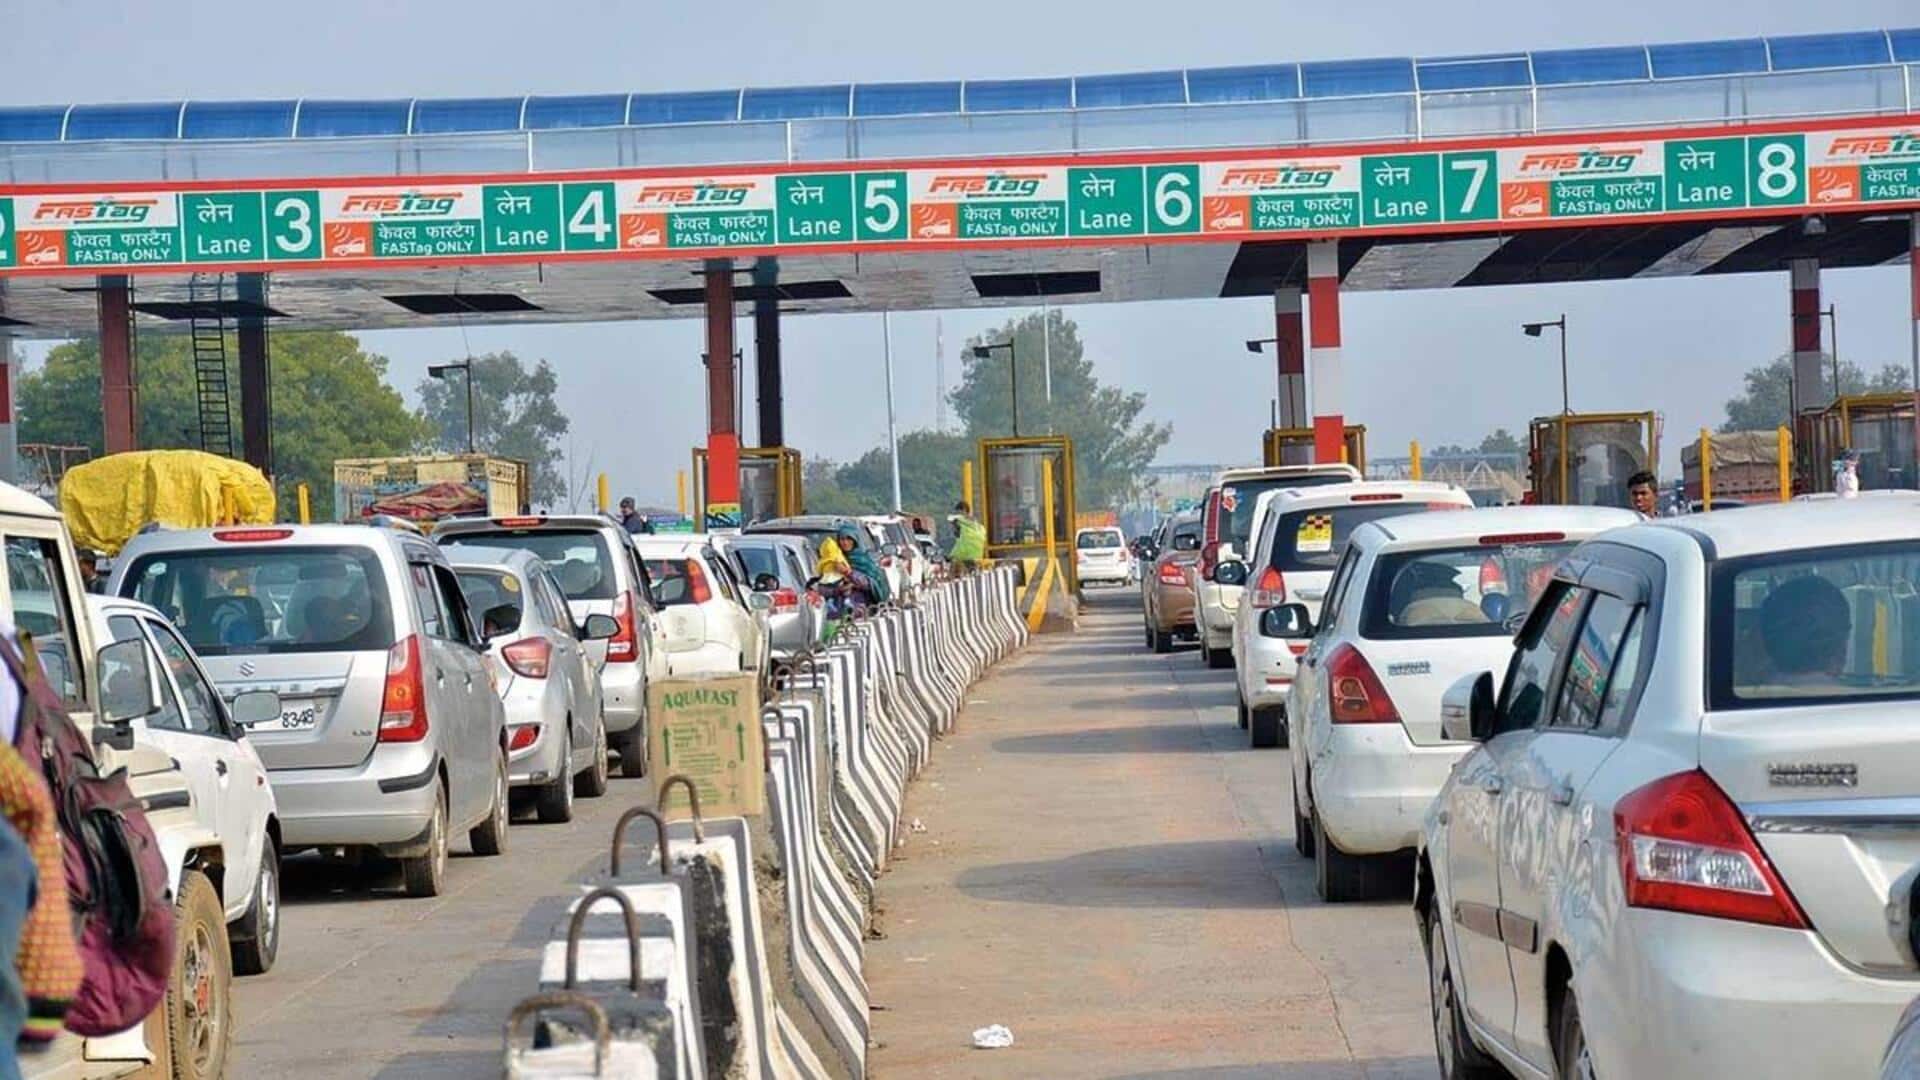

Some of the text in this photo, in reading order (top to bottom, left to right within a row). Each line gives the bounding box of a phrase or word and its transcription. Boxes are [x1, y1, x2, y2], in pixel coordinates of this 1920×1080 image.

[1677, 146, 1716, 171] लेन
[1374, 161, 1410, 186] लेन
[1758, 143, 1797, 198] 8
[1867, 167, 1907, 183] केवल
[788, 181, 824, 205] लेन
[1080, 173, 1115, 198] लेन
[1451, 159, 1488, 213] 7
[1556, 182, 1595, 198] केवल
[1678, 183, 1733, 202] Lane
[495, 190, 531, 215] लेन
[864, 179, 899, 233] 5
[1154, 172, 1192, 226] 6
[1256, 197, 1294, 213] केवल
[1375, 198, 1428, 218] Lane
[1559, 198, 1653, 214] FASTag ONLY
[197, 198, 233, 223] लेन
[569, 190, 611, 242] 4
[964, 206, 1001, 221] केवल
[1080, 209, 1132, 229] Lane
[274, 198, 312, 252] 3
[673, 214, 710, 230] केवल
[789, 217, 841, 236] Lane
[967, 222, 1057, 236] FASTag ONLY
[1259, 213, 1351, 229] FASTag ONLY
[72, 232, 111, 247] केवल
[378, 224, 416, 240] केवल
[496, 226, 549, 246] Lane
[676, 230, 766, 245] FASTag ONLY
[197, 235, 251, 254] Lane
[381, 240, 473, 256] FASTag ONLY
[75, 248, 171, 263] FASTag ONLY
[664, 688, 738, 709] AQUAFAST
[282, 708, 315, 728] 8348
